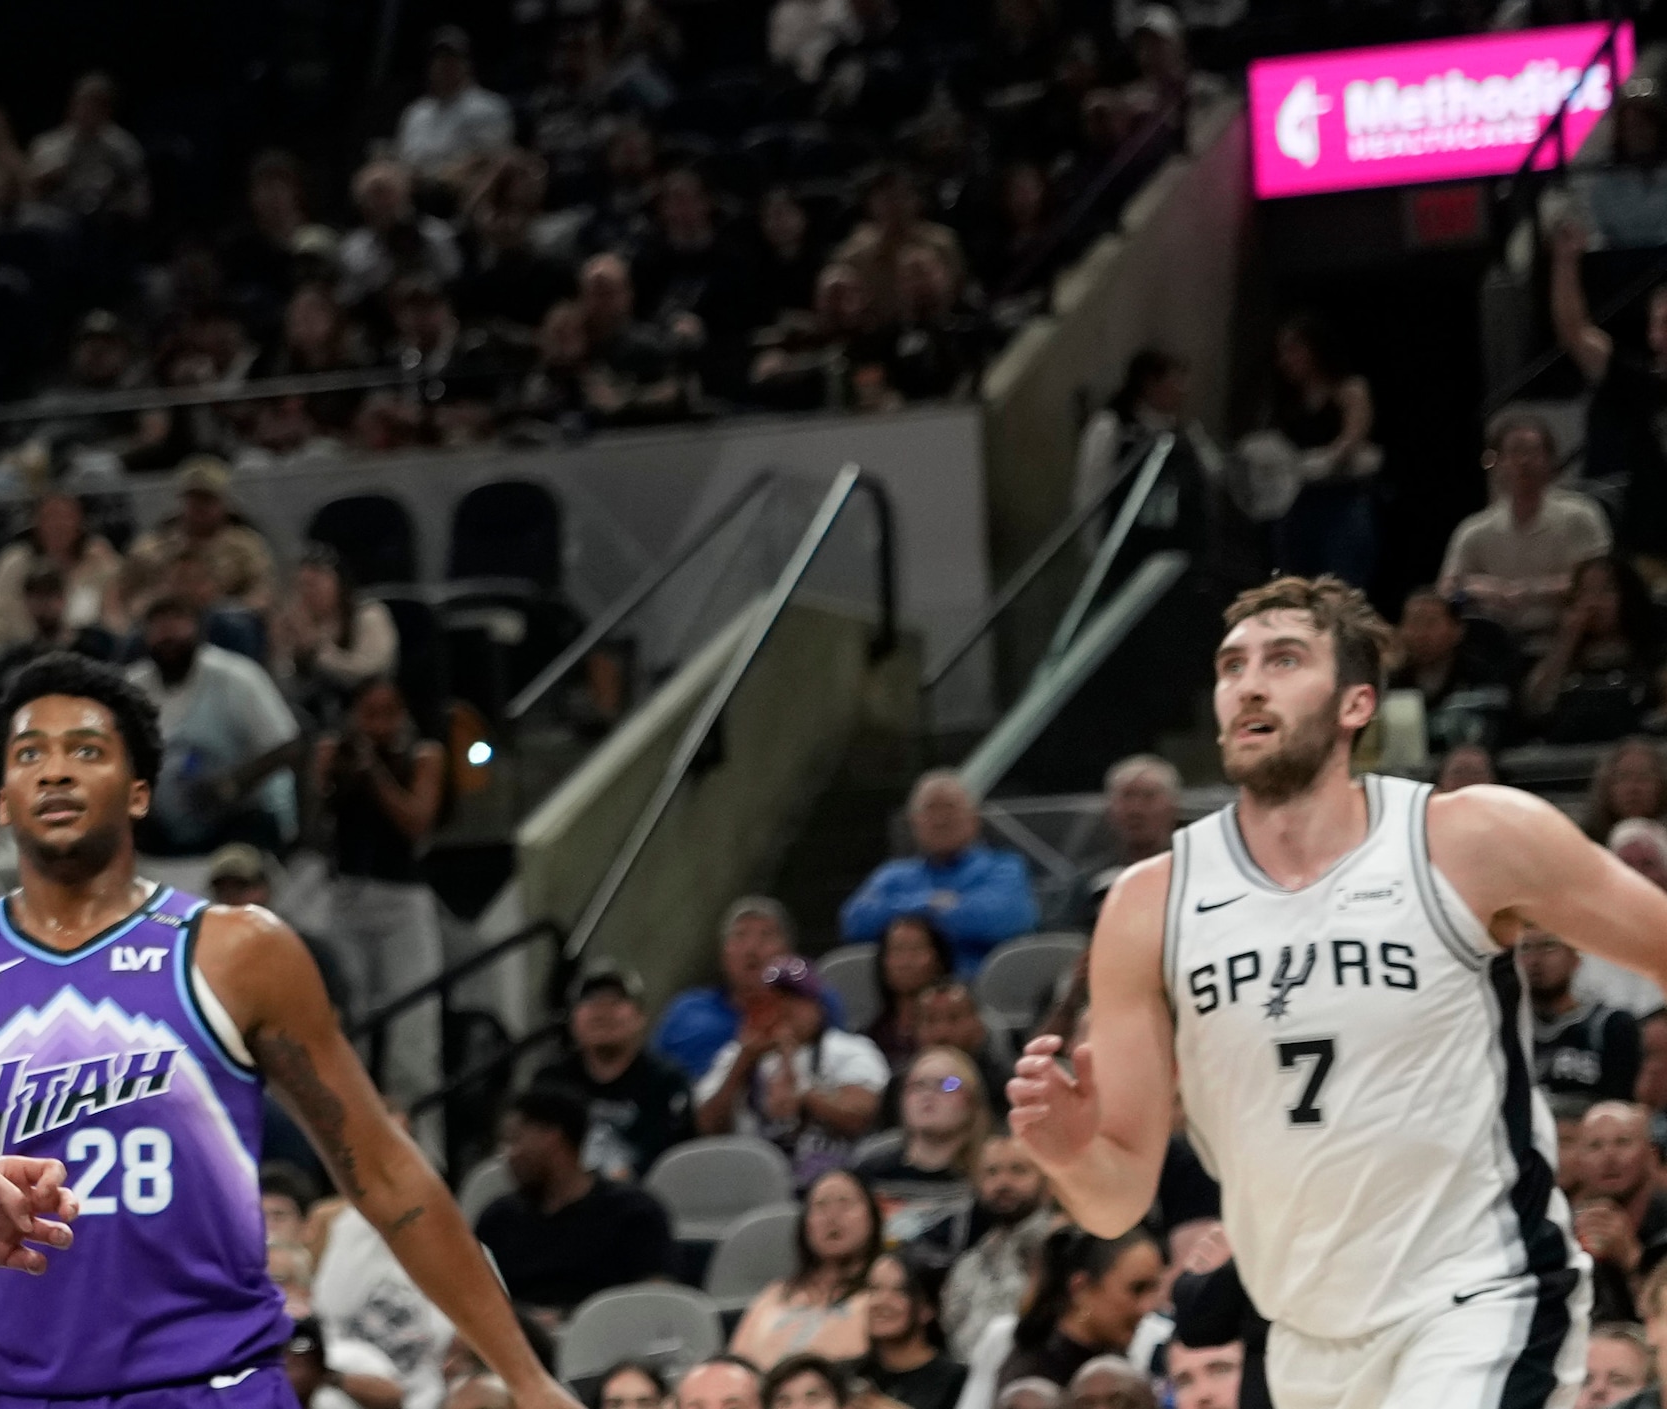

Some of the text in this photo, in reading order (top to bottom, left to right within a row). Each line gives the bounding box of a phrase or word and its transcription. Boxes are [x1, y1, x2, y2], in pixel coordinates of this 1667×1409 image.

[110, 945, 170, 972] LVT
[1189, 939, 1418, 1020] SPURS
[1270, 1033, 1341, 1130] 7
[67, 1126, 174, 1216] 28
